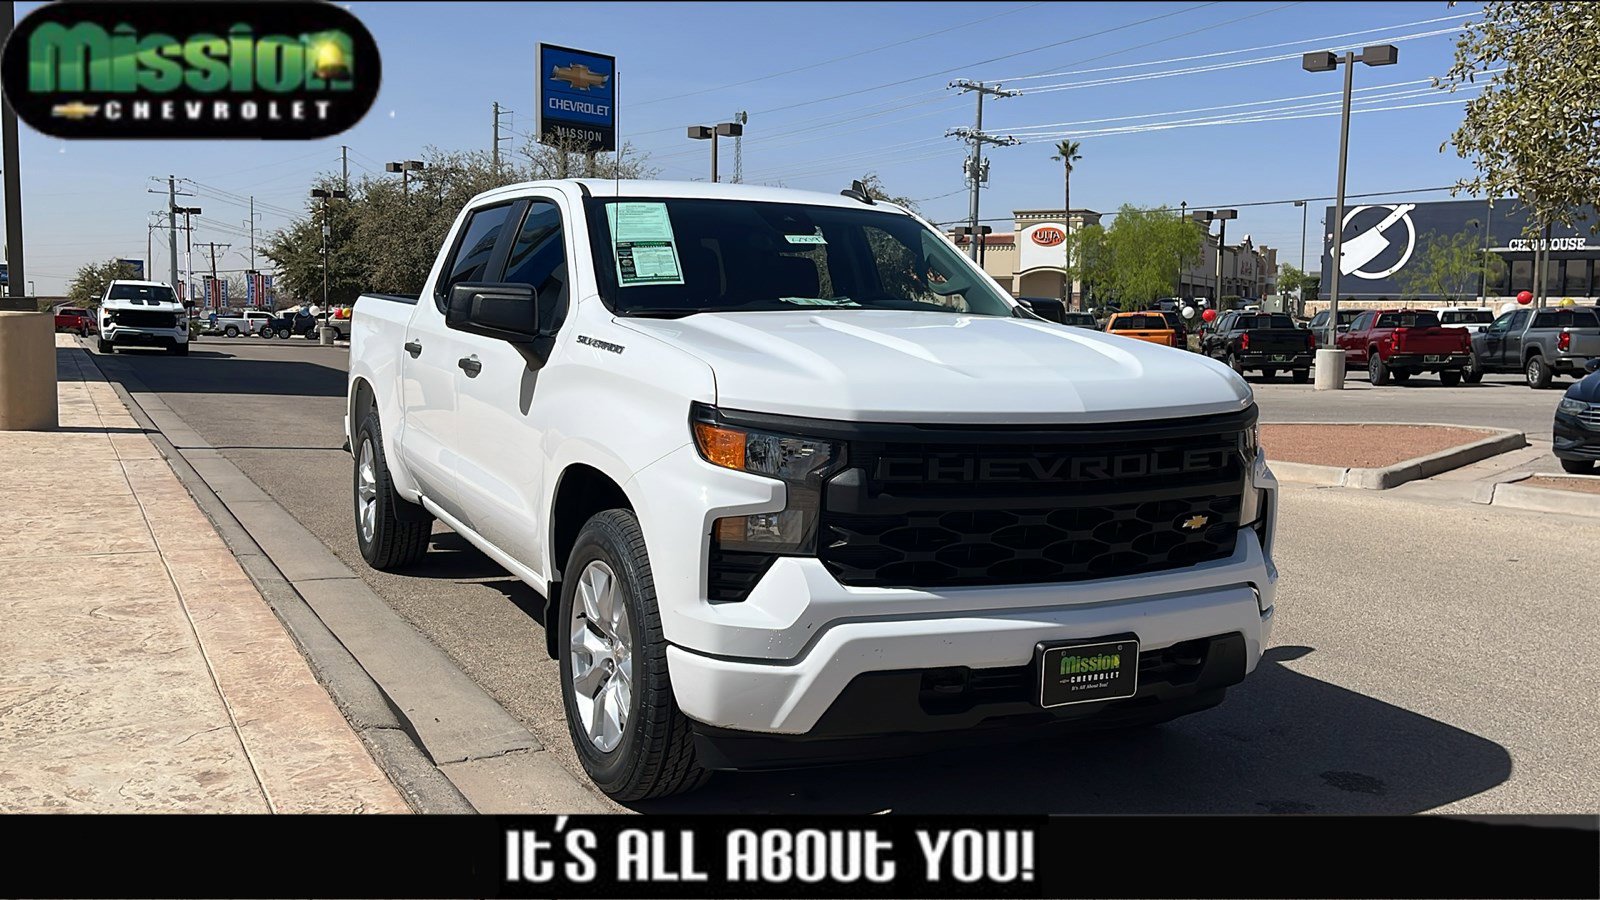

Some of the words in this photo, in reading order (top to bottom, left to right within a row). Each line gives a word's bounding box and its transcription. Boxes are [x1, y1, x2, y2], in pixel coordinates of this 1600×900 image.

[548, 97, 610, 117] CHEVROLET
[557, 125, 602, 142] MISSION
[576, 335, 626, 354] SILVERADO
[875, 446, 1237, 482] CHEVROLET
[1070, 671, 1120, 683] CHEVROLET
